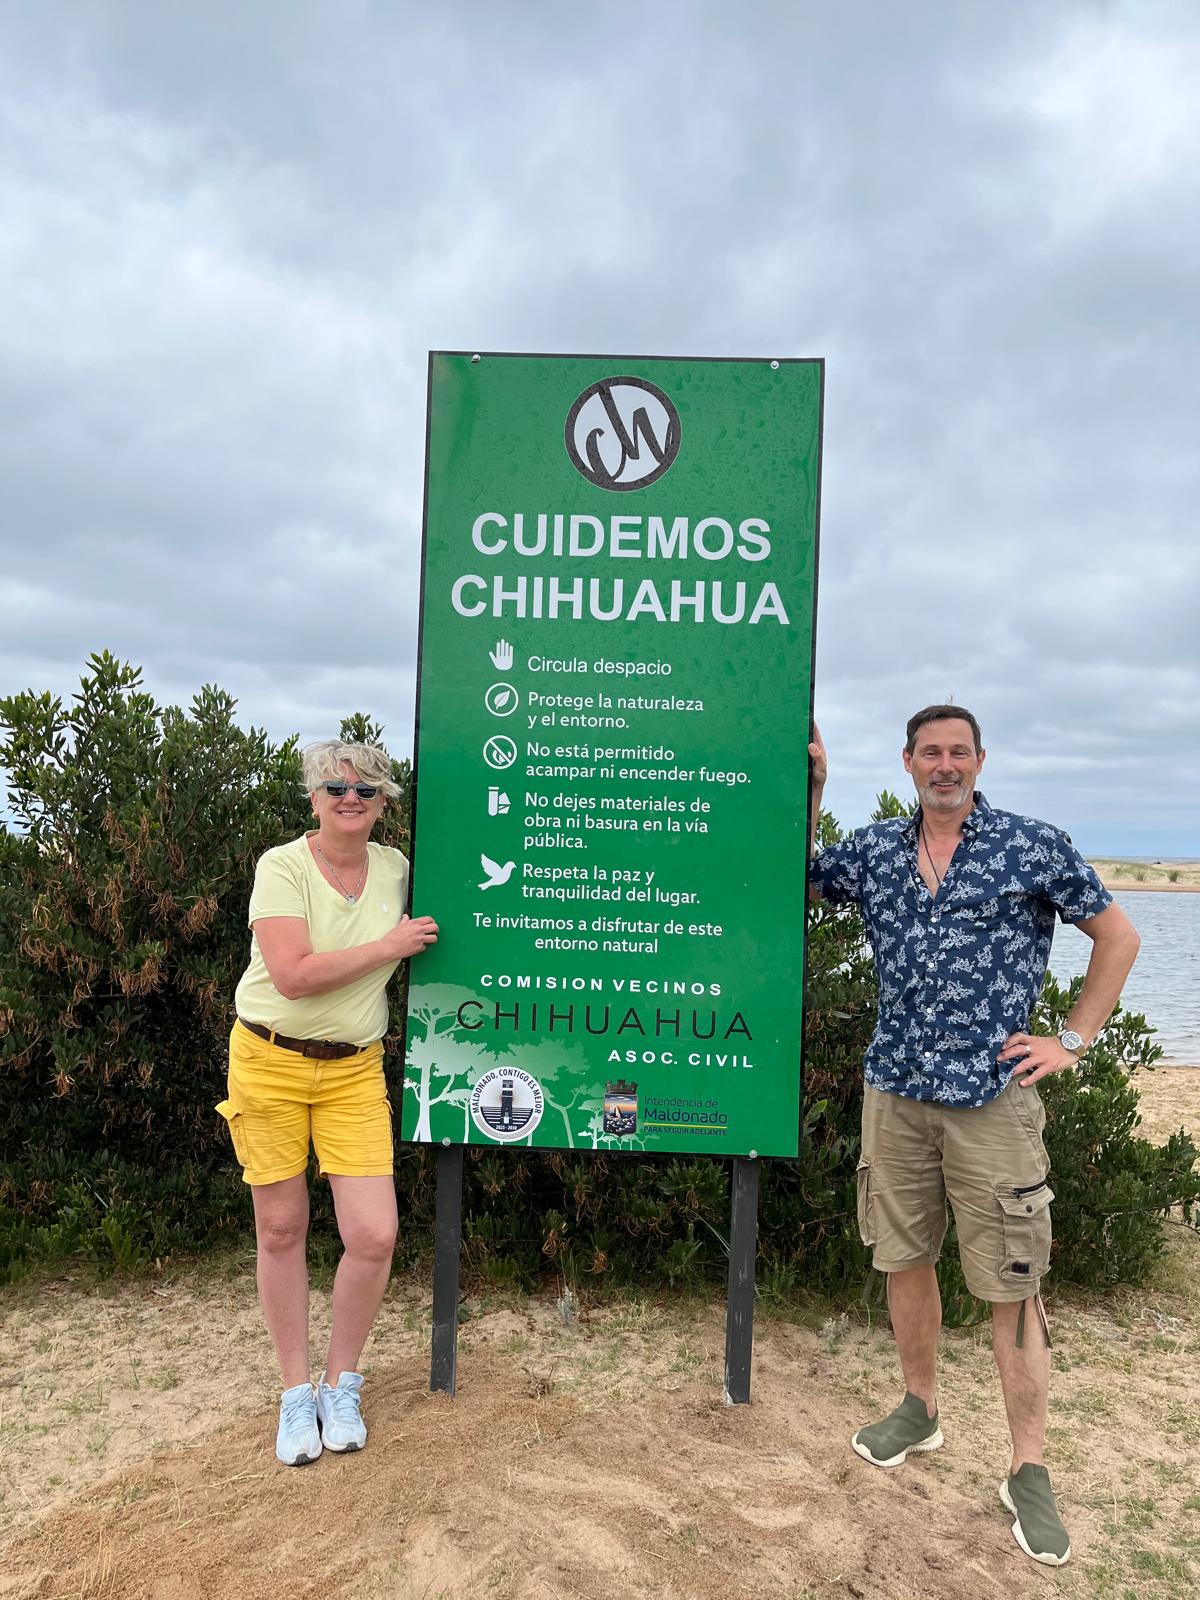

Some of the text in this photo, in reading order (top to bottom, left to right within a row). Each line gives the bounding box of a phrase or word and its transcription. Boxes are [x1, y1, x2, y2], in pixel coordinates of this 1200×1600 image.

[471, 512, 772, 562] CUIDEMOS
[451, 574, 791, 625] CHIHUAHUA
[527, 655, 672, 678] Circula despacio
[528, 692, 704, 711] Protege la naturaleza
[527, 712, 630, 730] y el entorno.
[526, 742, 675, 762] No está permitido
[525, 765, 752, 787] acampar ni encender fuego.
[525, 792, 711, 813] No dejes materiales de
[524, 815, 709, 833] obra ni basura en la vía
[524, 833, 588, 851] pública.
[522, 863, 655, 885] Respeta la paz y
[522, 885, 701, 907] tranquilidad del lugar.
[473, 913, 723, 937] Te invitamos a disfrutar de este
[534, 936, 659, 954] entorno natural
[480, 974, 722, 996] COMISION VECINOS
[457, 1000, 753, 1041] CHIHUAHUA
[608, 1049, 754, 1069] ASOC. CIVIL
[472, 1069, 542, 1114] MALDONADO, CONTIGO ES MEJOR
[644, 1096, 718, 1109] Intendencia de
[644, 1108, 728, 1124] Maldonado
